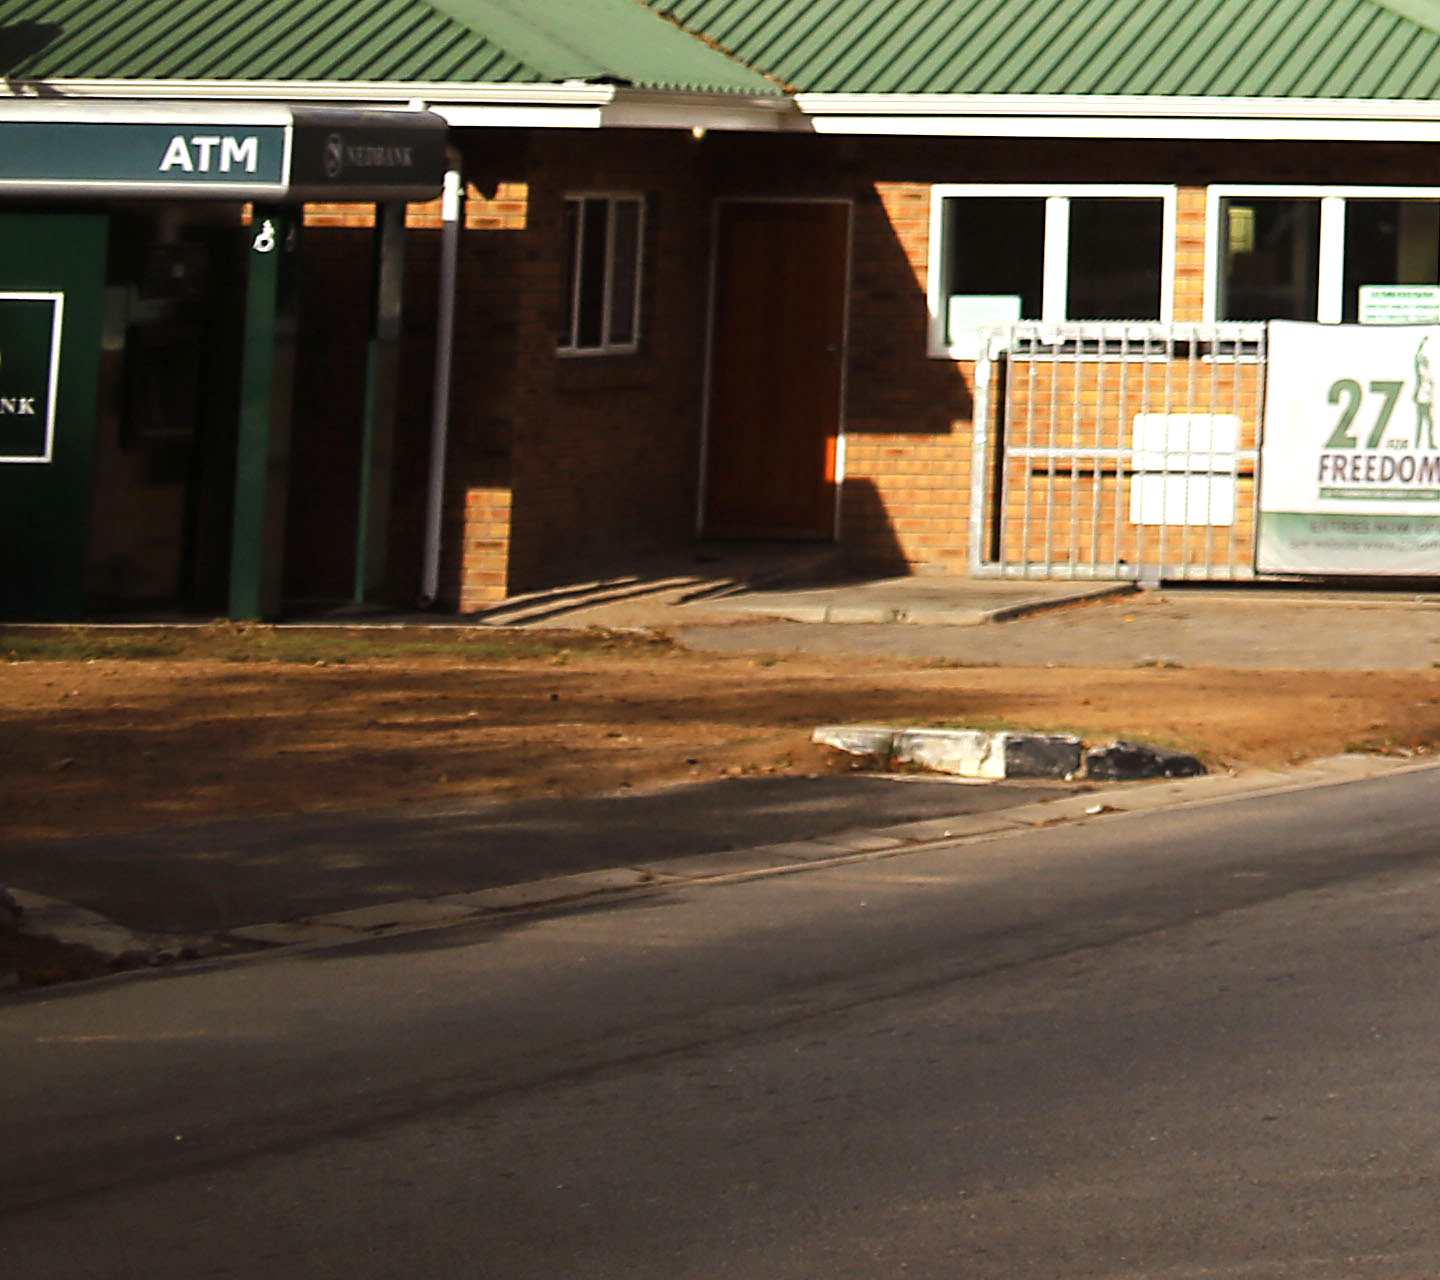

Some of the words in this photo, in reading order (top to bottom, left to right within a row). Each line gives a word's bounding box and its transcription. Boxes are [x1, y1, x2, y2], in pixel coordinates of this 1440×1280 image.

[159, 136, 258, 172] ATM
[345, 146, 413, 167] NEDBANK
[1325, 378, 1404, 449] 27
